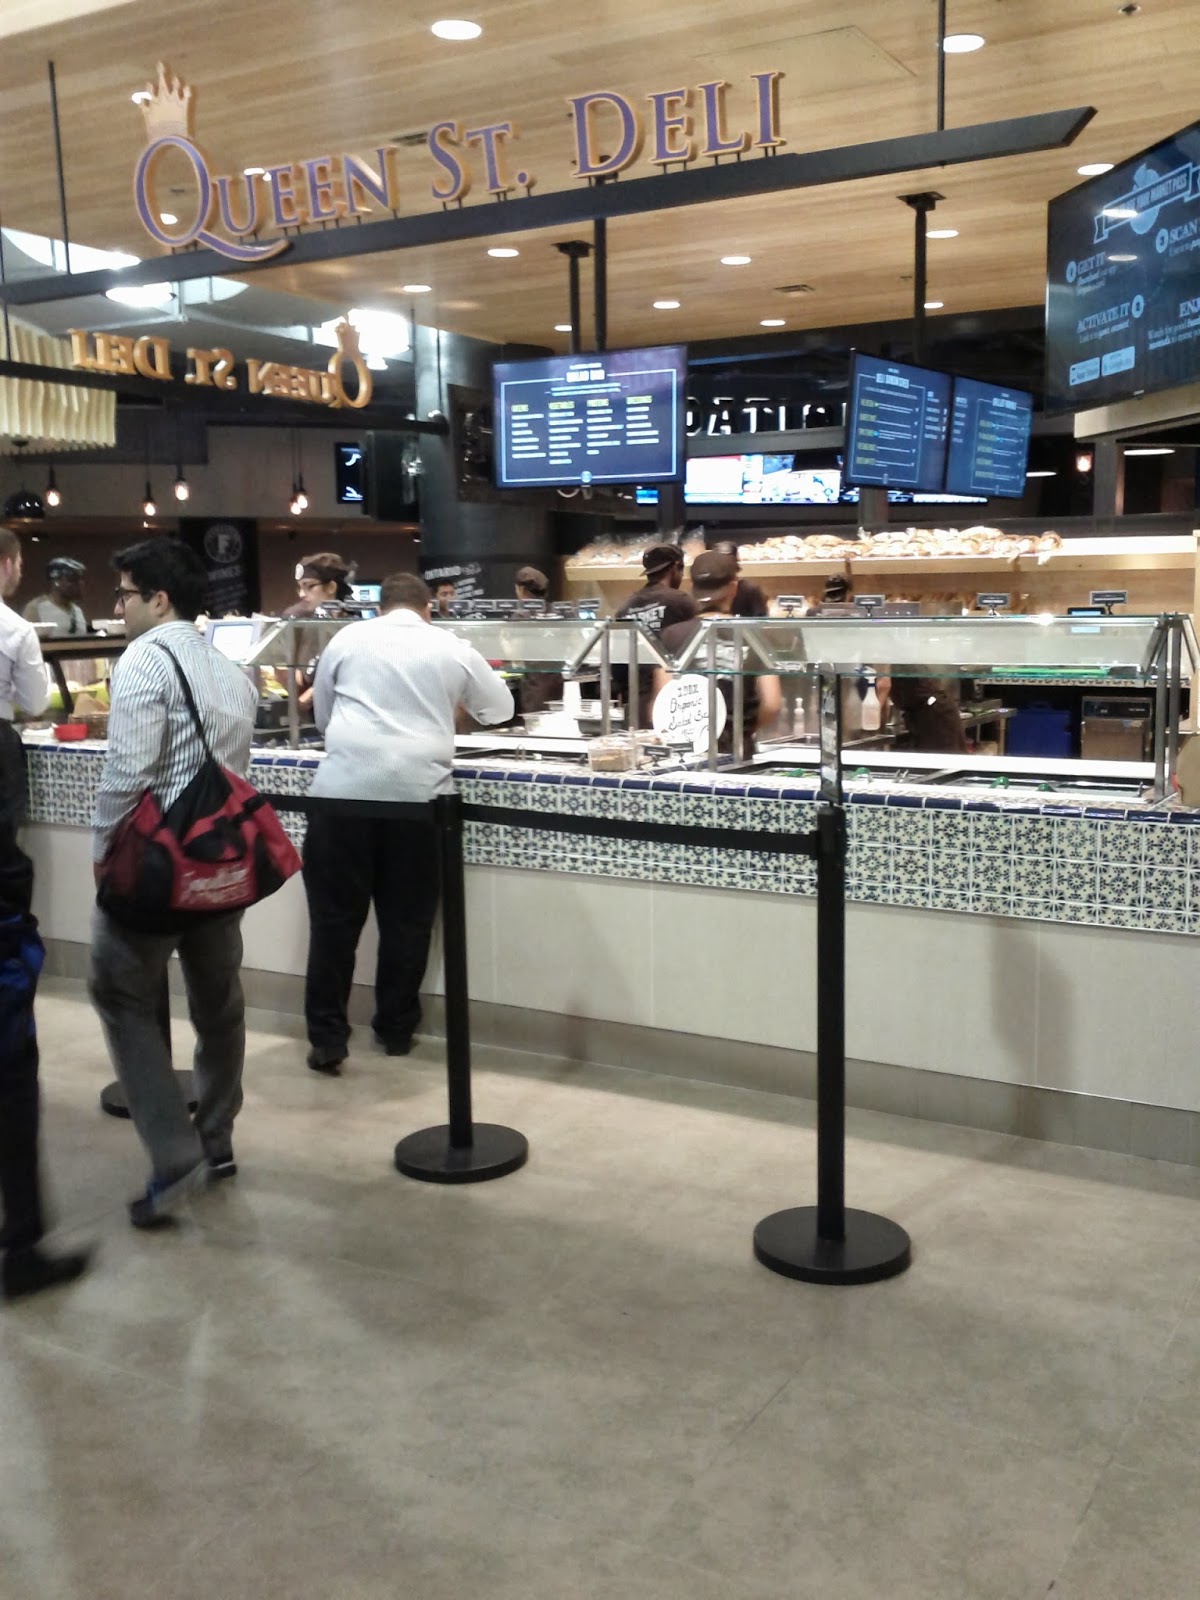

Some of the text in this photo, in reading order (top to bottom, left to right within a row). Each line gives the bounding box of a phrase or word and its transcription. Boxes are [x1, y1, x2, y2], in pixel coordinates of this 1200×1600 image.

[135, 71, 787, 261] QUEEN ST. DELI
[1169, 220, 1198, 244] SCAN
[1077, 306, 1119, 333] ACTIVATE
[1120, 302, 1130, 317] IT
